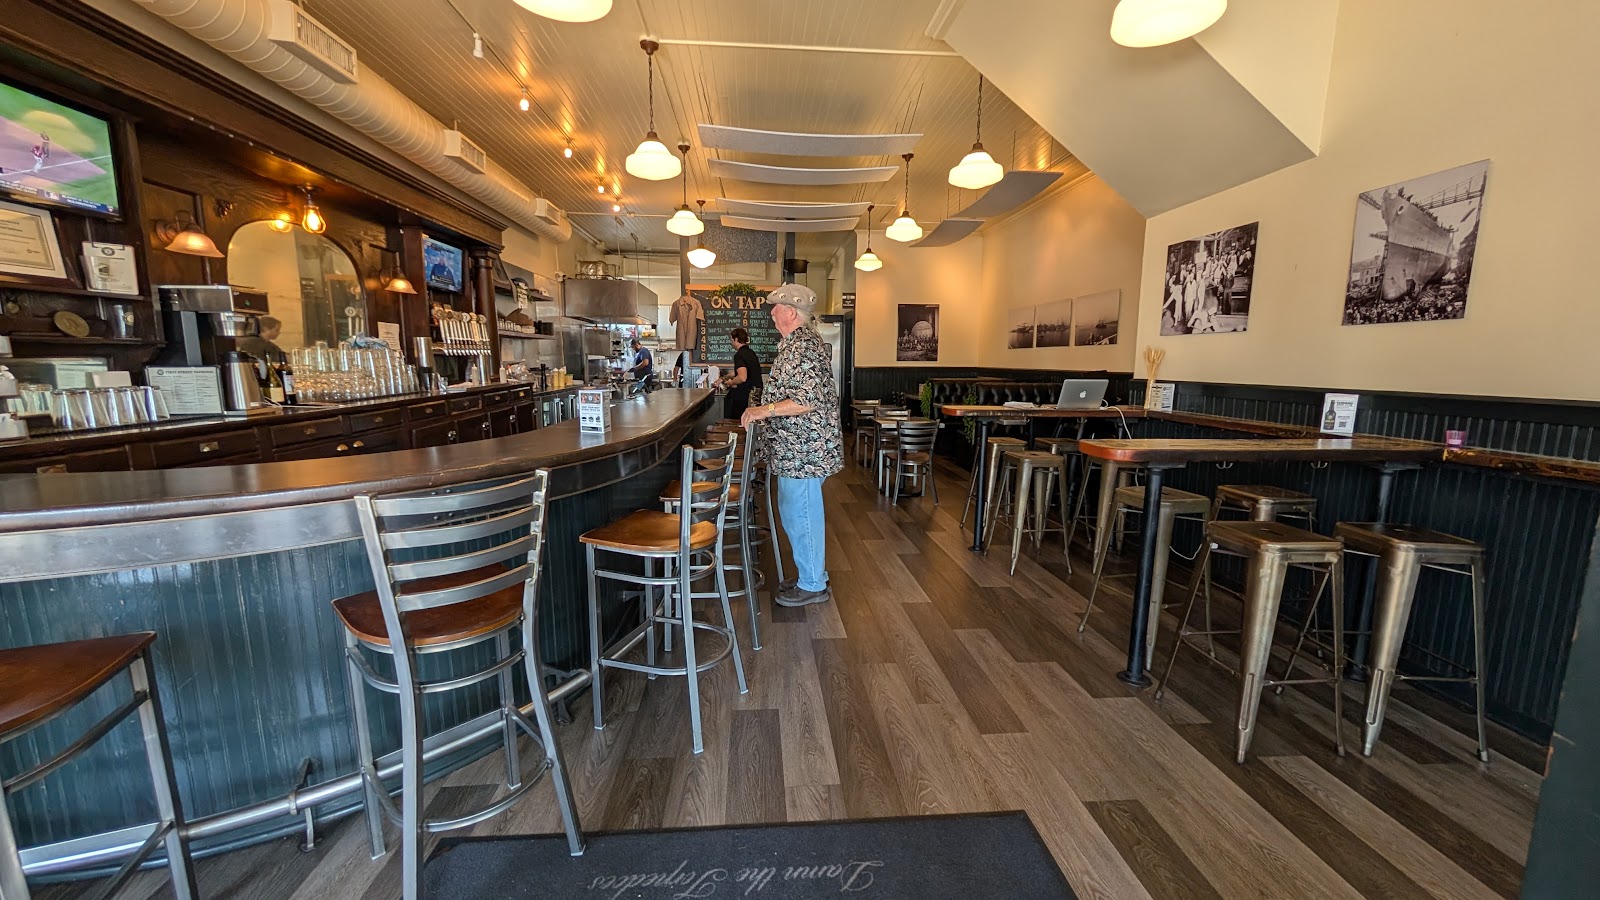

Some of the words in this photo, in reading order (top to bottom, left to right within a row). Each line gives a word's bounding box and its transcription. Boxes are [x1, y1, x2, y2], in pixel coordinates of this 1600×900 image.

[711, 295, 732, 309] ON
[736, 296, 766, 309] TAP
[743, 310, 748, 318] 7
[743, 319, 748, 327] 8
[701, 327, 706, 335] 3
[701, 336, 706, 344] 4
[701, 344, 706, 352] 5
[701, 353, 706, 361] 6
[587, 860, 728, 900] Torpedoes
[784, 860, 884, 893] Damn
[735, 866, 777, 896] the
